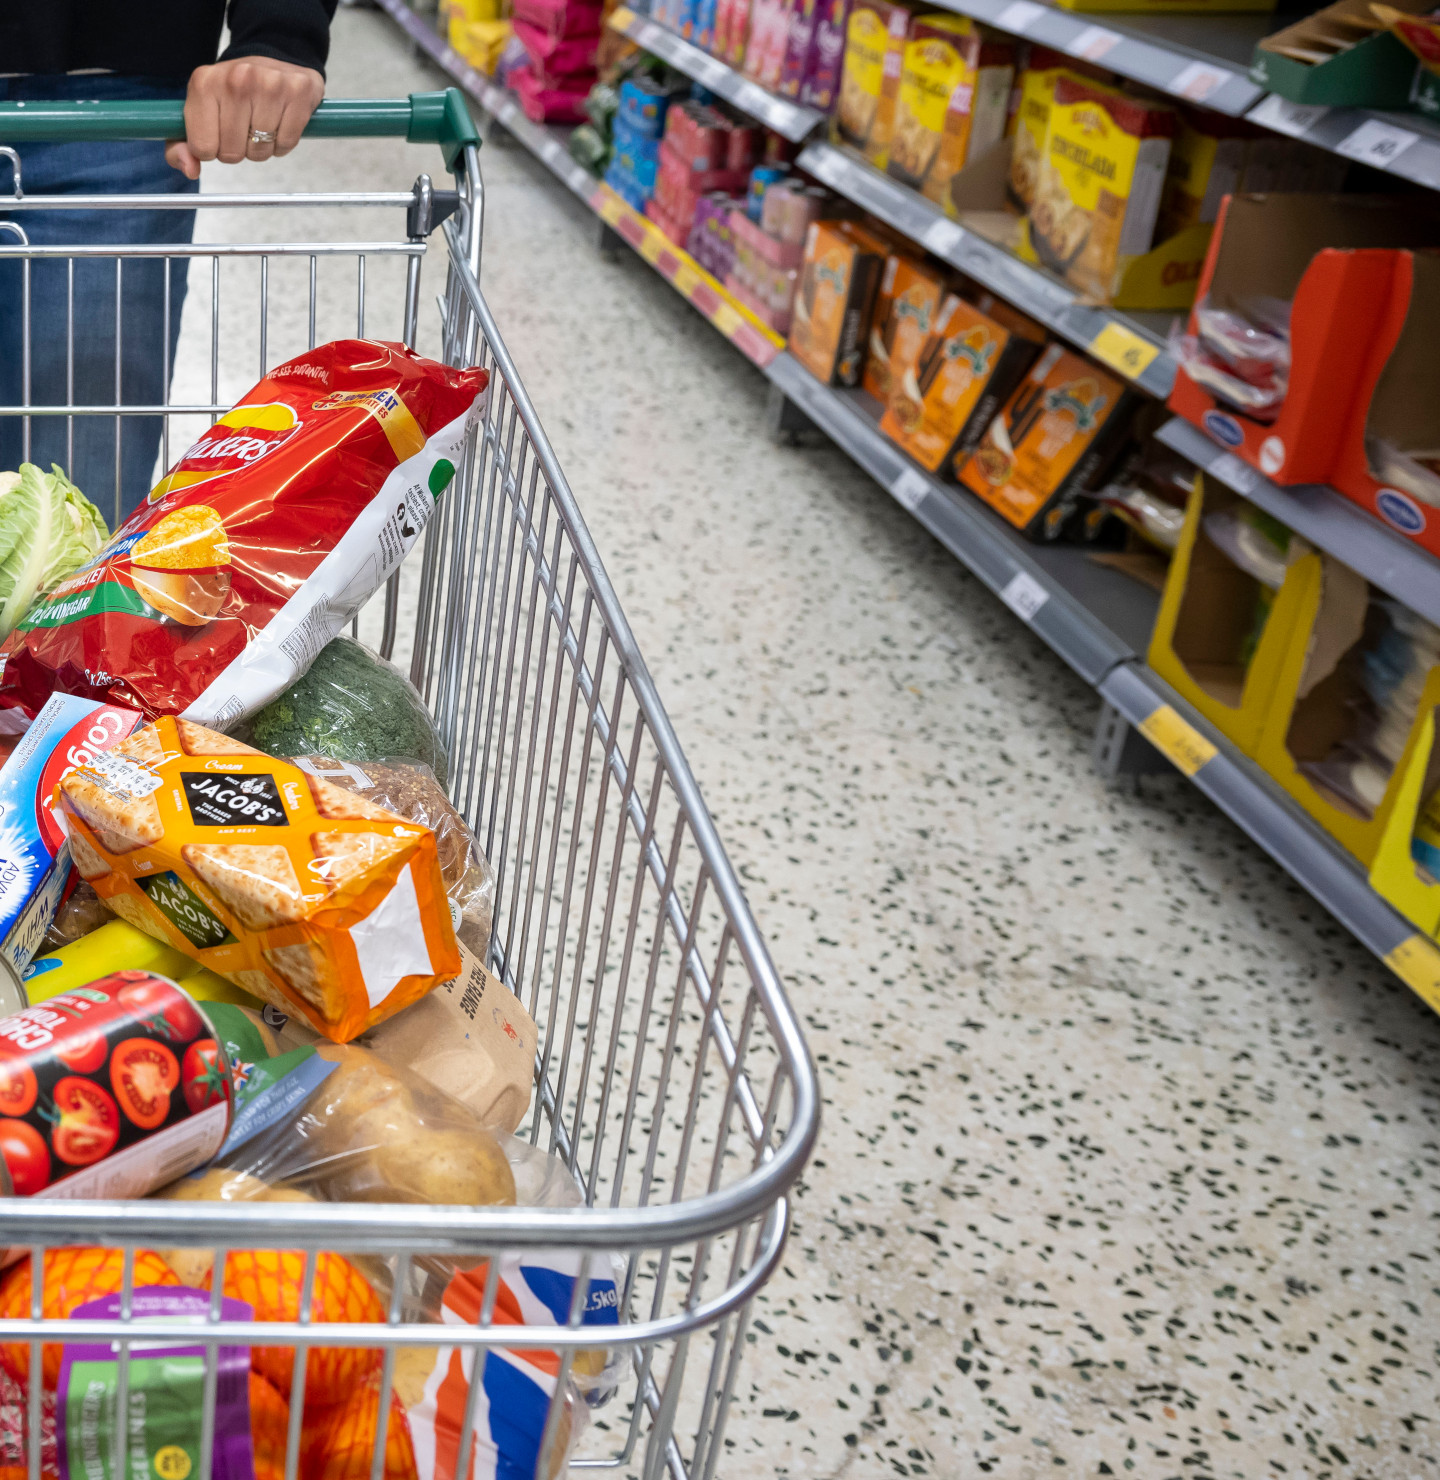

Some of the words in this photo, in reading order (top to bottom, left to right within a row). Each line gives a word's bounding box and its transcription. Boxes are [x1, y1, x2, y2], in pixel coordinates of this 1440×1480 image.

[179, 436, 281, 463] ALKERS
[51, 596, 91, 620] VINEGAR
[205, 760, 244, 771] Cream
[190, 778, 277, 822] JACOB'S
[201, 802, 214, 811] THE
[212, 807, 232, 820] BAKER
[194, 806, 226, 824] BROTHERS
[150, 885, 224, 938] JACOB'S
[12, 895, 49, 965] WHITE
[470, 962, 487, 991] FREE
[460, 981, 483, 1021] RANGE
